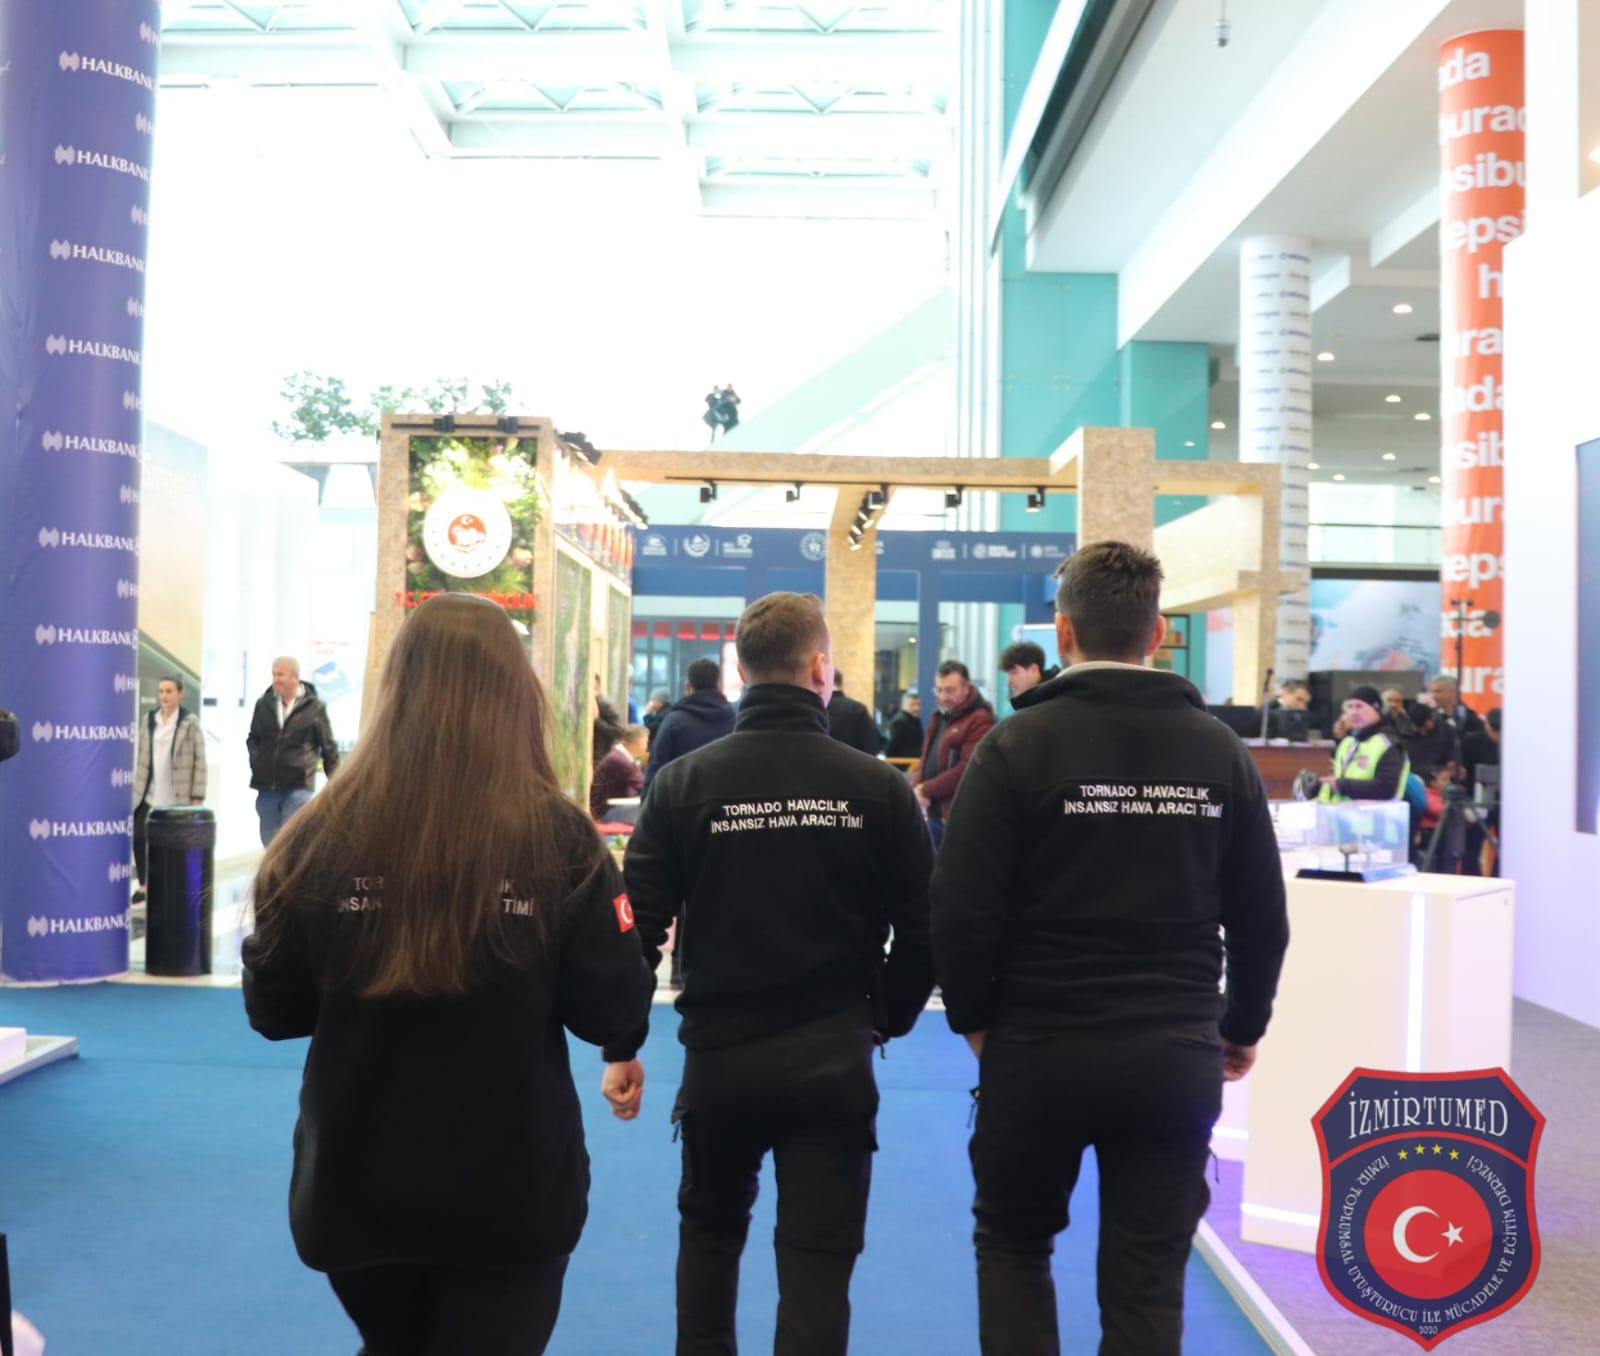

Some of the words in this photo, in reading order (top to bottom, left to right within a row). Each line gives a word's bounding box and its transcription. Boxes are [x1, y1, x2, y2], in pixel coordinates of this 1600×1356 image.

[1080, 784, 1137, 798] TORNADO
[1143, 785, 1210, 800] HAVACILIK
[723, 802, 782, 817] TORNADO
[787, 799, 849, 813] HAVACILIK
[1064, 799, 1118, 815] İNSANSIZ
[1121, 801, 1153, 815] HAVA
[1157, 802, 1196, 816] ARACI
[1200, 802, 1223, 818] TİMİ
[52, 819, 128, 837] HALKBANK
[711, 817, 765, 834] İNSANSIZ
[769, 816, 797, 829] HAVA
[800, 814, 837, 828] ARACI
[840, 813, 864, 829] TİMİ
